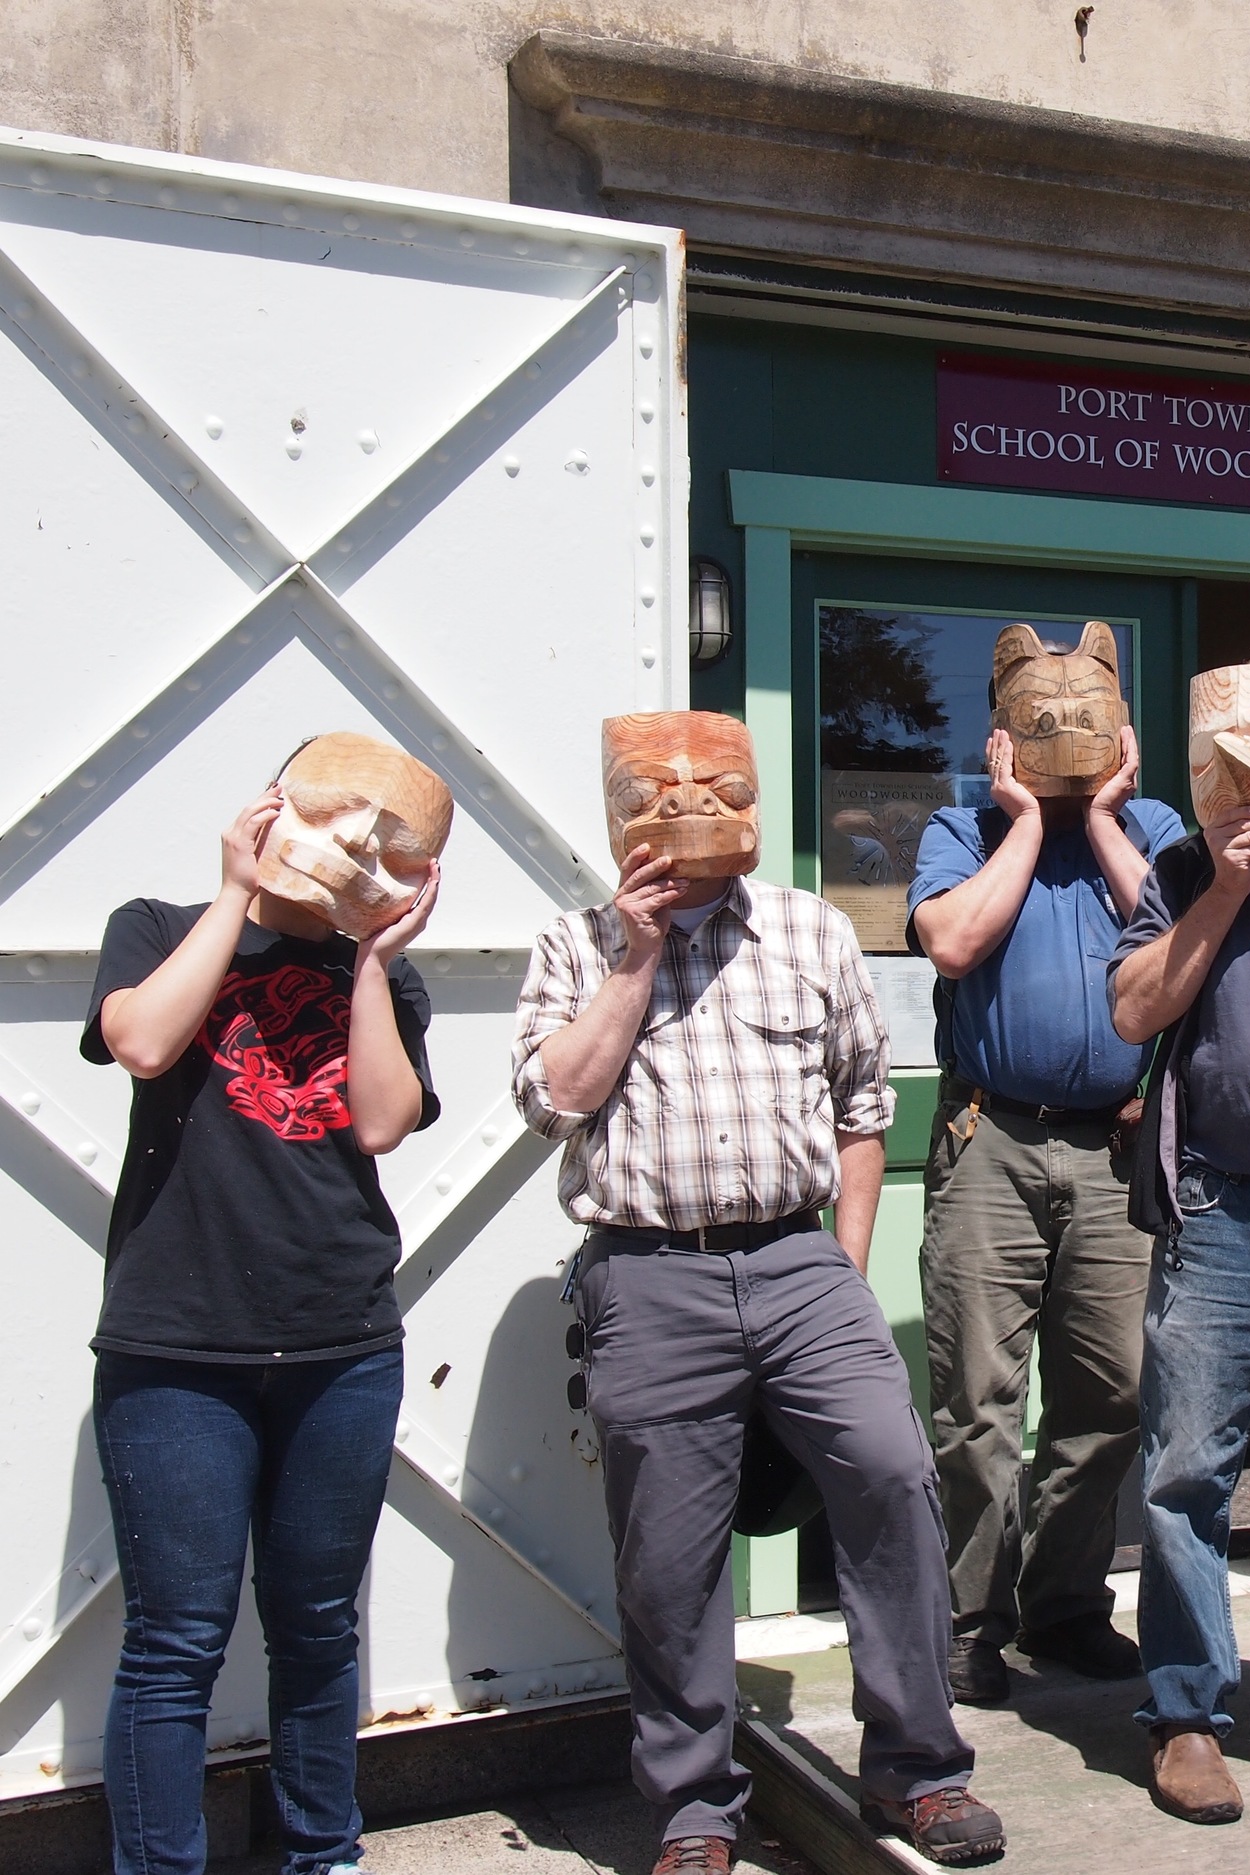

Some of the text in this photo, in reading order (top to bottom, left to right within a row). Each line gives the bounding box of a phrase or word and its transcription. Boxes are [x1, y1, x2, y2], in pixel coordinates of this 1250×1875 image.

[1056, 383, 1154, 423] PORT
[952, 421, 1104, 470] SCHOOL
[1114, 438, 1161, 470] OF
[837, 789, 944, 801] WOODWORKING
